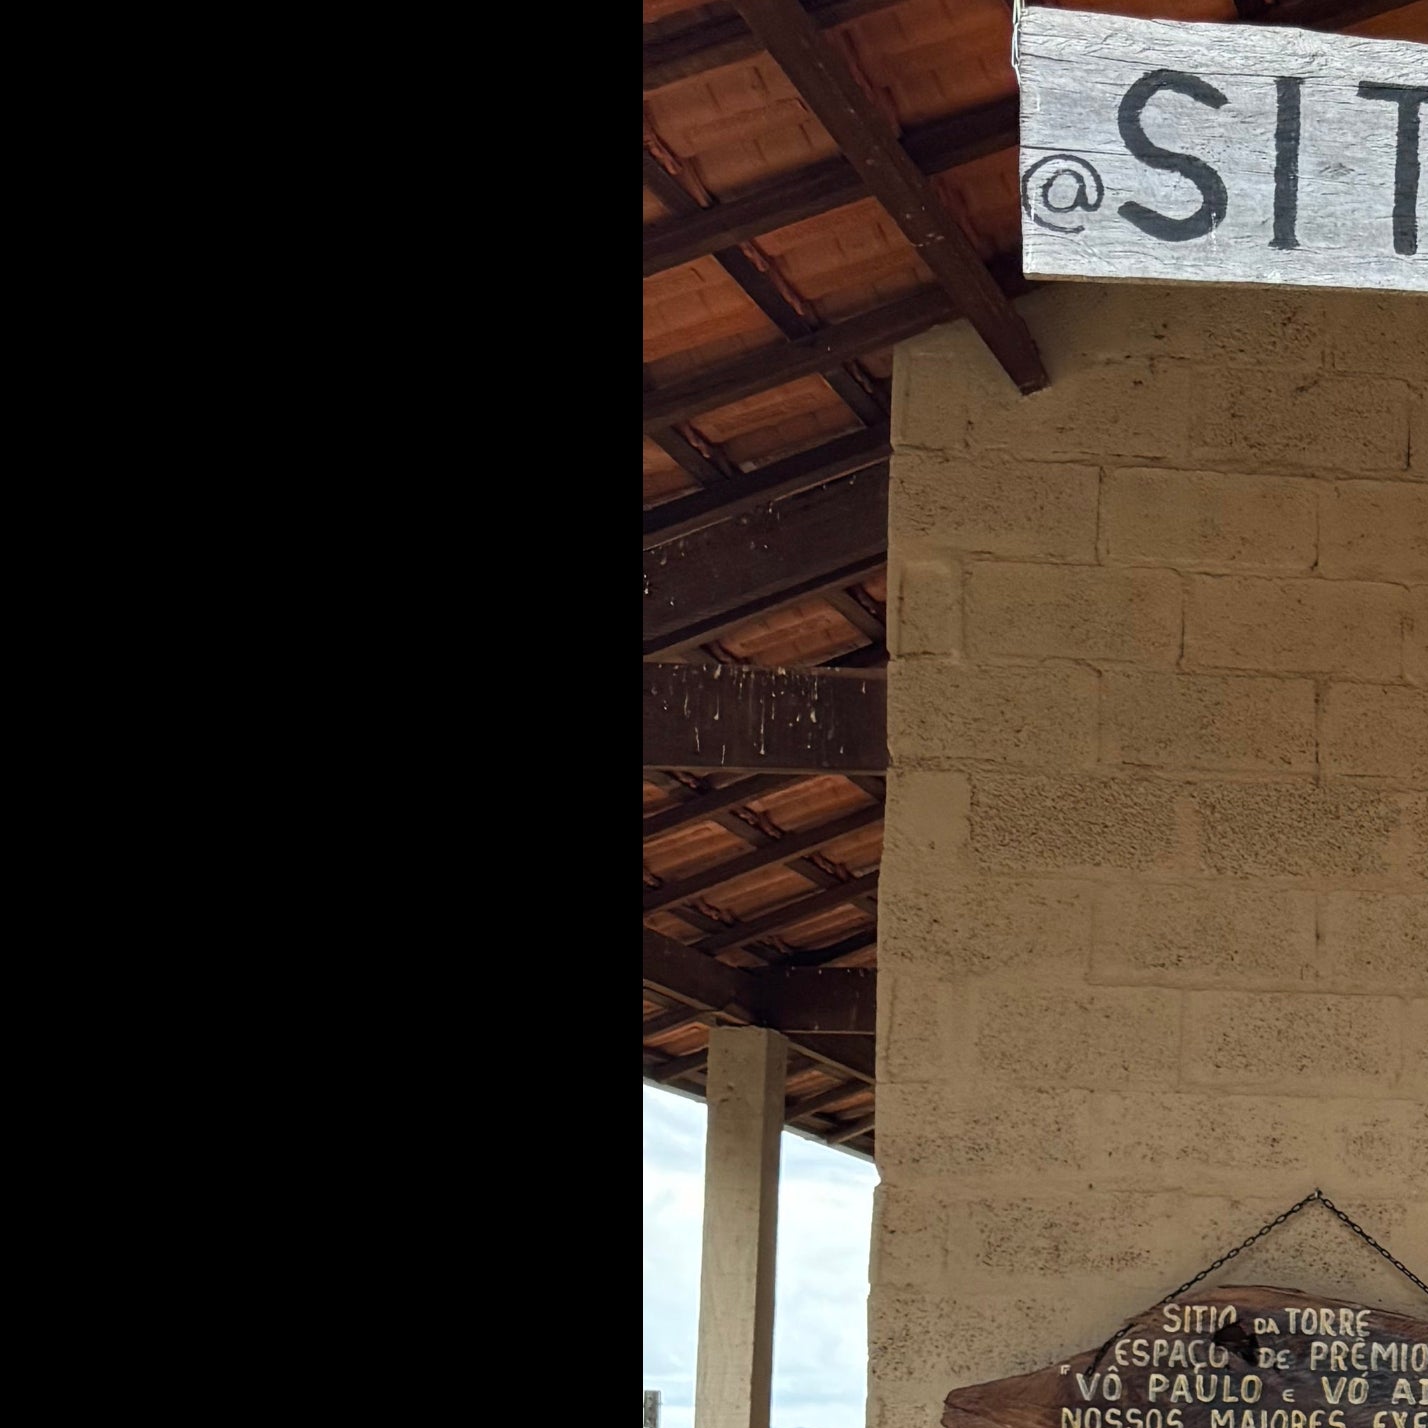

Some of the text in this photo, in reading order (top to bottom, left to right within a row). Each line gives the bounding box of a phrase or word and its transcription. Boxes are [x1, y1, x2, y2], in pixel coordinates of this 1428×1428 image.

[1162, 1303, 1371, 1337] SITIO DA TORRE
[1114, 1338, 1229, 1374] ESPAÇO
[1258, 1347, 1291, 1370] DE
[1148, 1373, 1263, 1404] PAULO
[1321, 1371, 1370, 1405] VÓ
